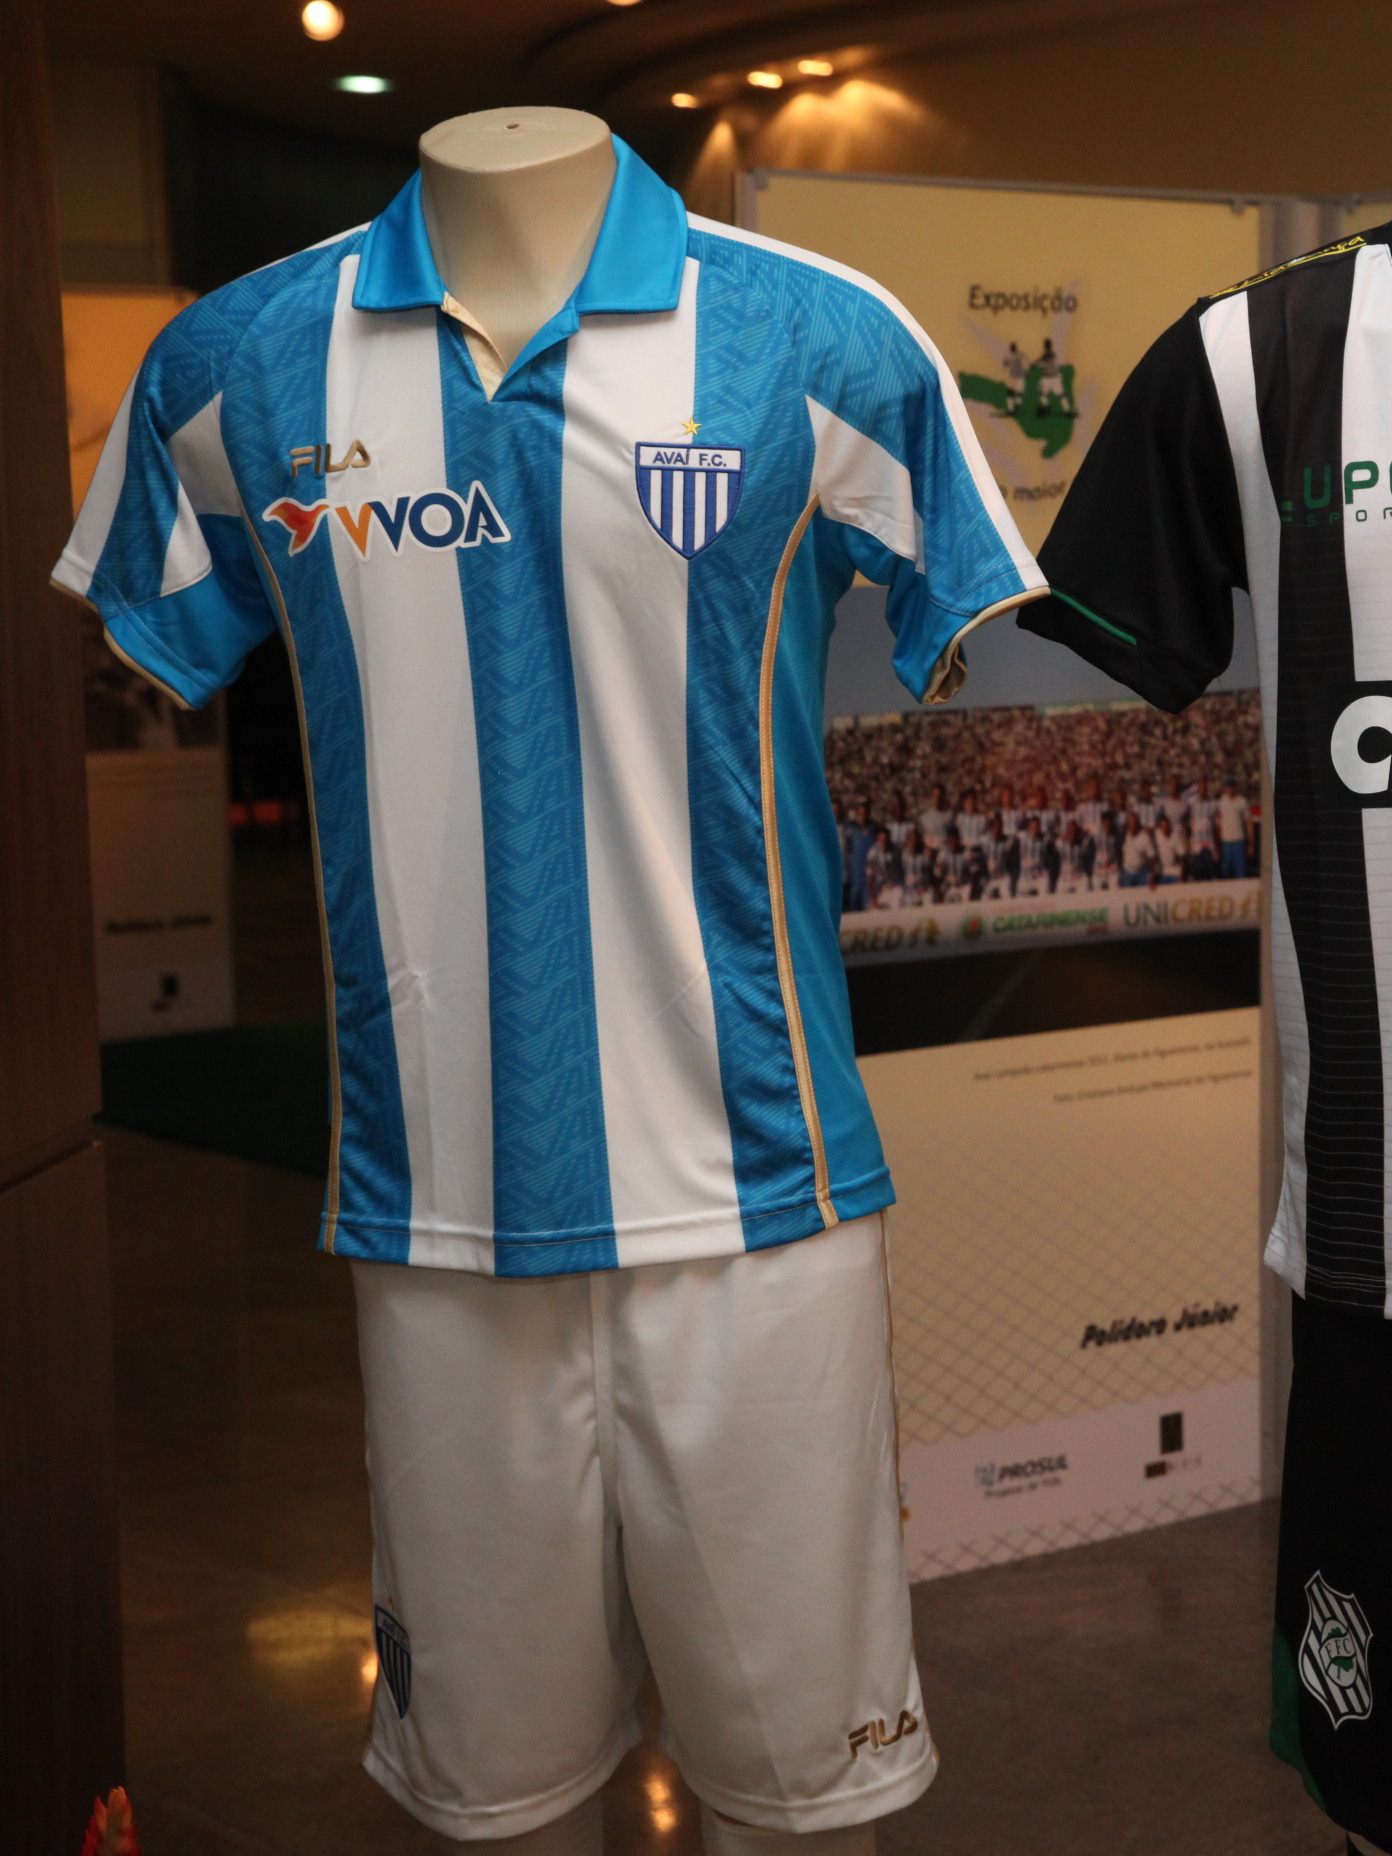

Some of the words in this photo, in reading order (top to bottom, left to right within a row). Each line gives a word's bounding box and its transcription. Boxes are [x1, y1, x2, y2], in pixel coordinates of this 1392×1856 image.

[968, 285, 1078, 317] Exposição
[290, 439, 370, 478] FILA
[698, 453, 727, 467] F.C.
[1123, 895, 1236, 928] UNICRED
[1080, 1317, 1167, 1349] Polidoro
[848, 1710, 918, 1759] FILA
